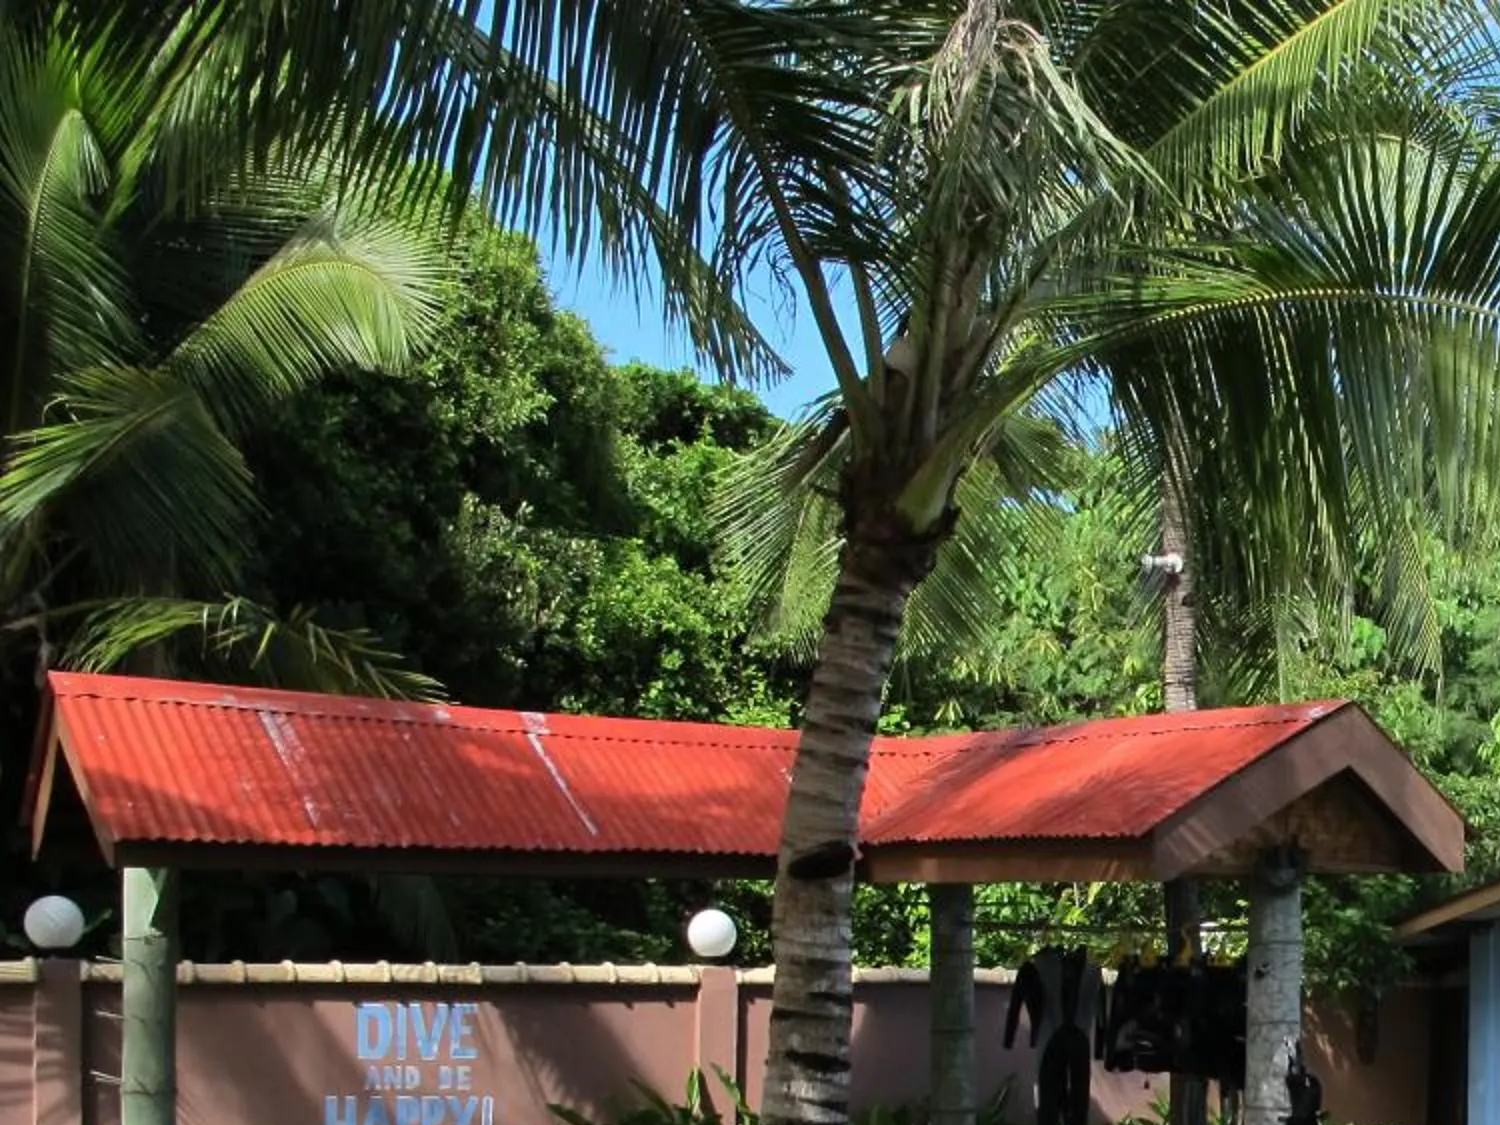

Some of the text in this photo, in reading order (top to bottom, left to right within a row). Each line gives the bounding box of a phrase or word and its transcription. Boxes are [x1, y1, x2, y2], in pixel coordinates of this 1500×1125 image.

[356, 1002, 479, 1061] DIVE
[364, 1065, 473, 1090] AND BE
